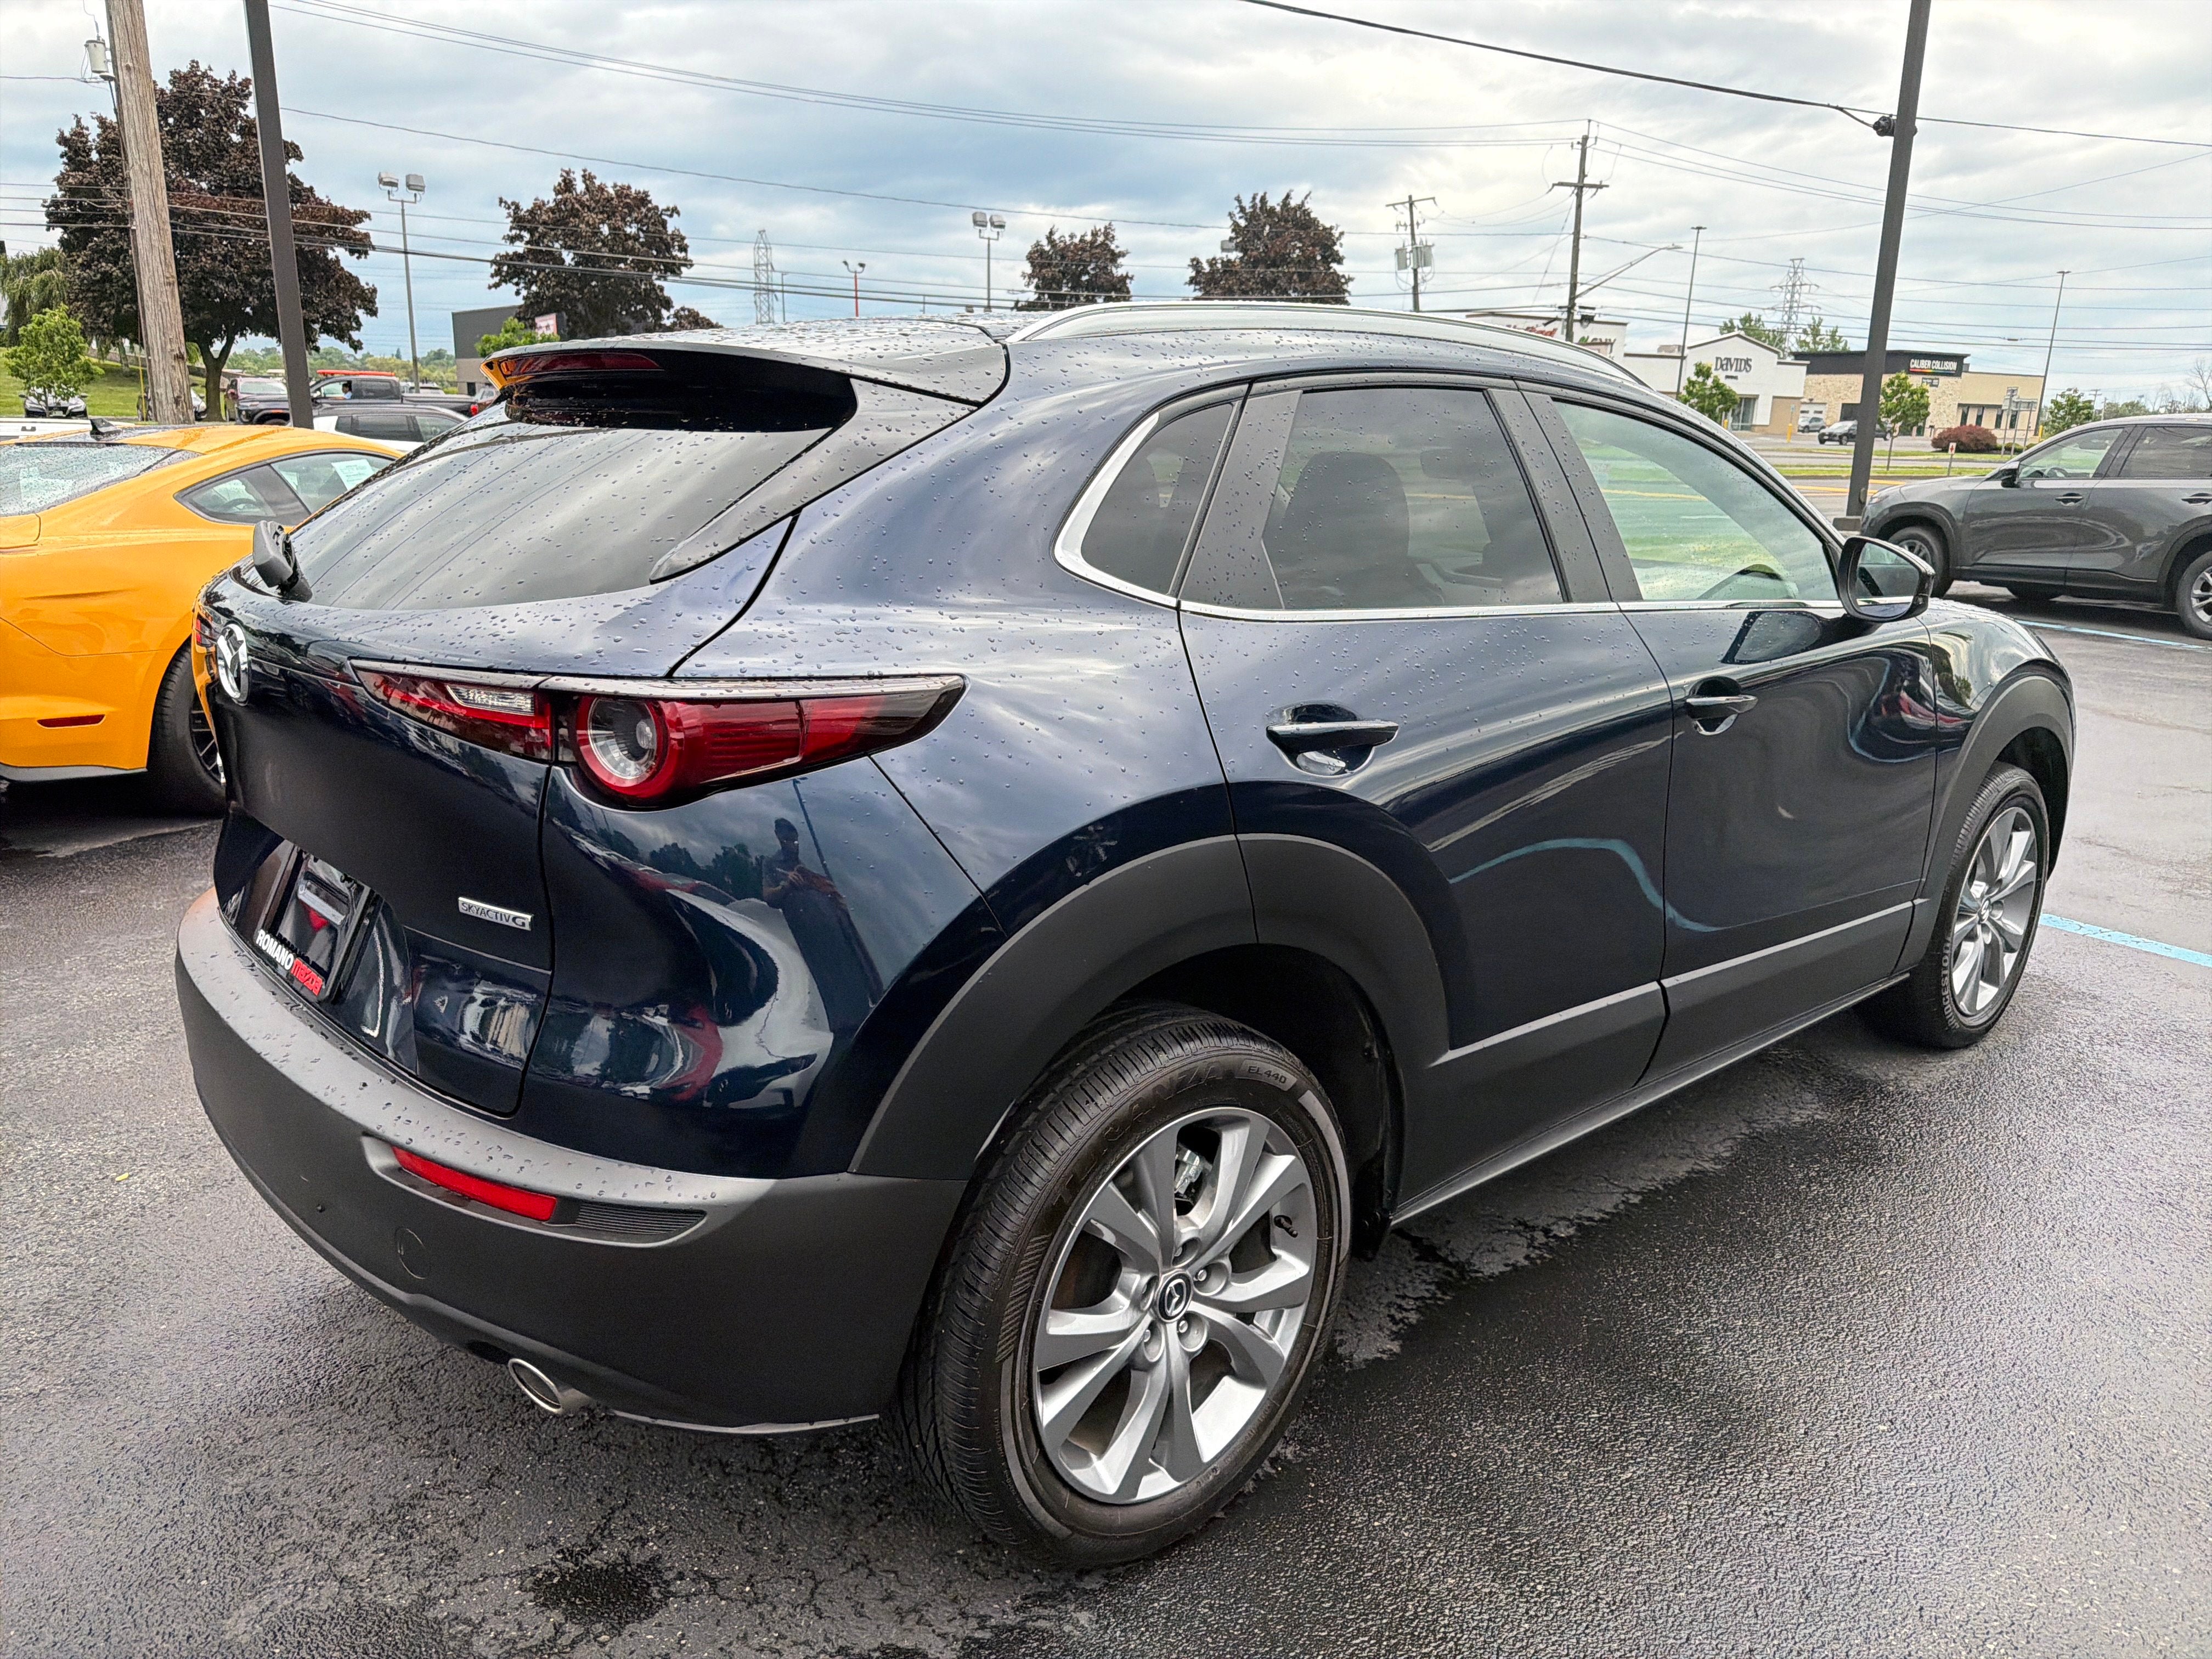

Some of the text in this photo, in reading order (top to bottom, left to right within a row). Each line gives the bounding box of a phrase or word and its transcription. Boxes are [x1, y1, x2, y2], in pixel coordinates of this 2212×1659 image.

[1910, 358, 1957, 371] CALIBER COLLISION
[256, 929, 294, 970] ROMANO
